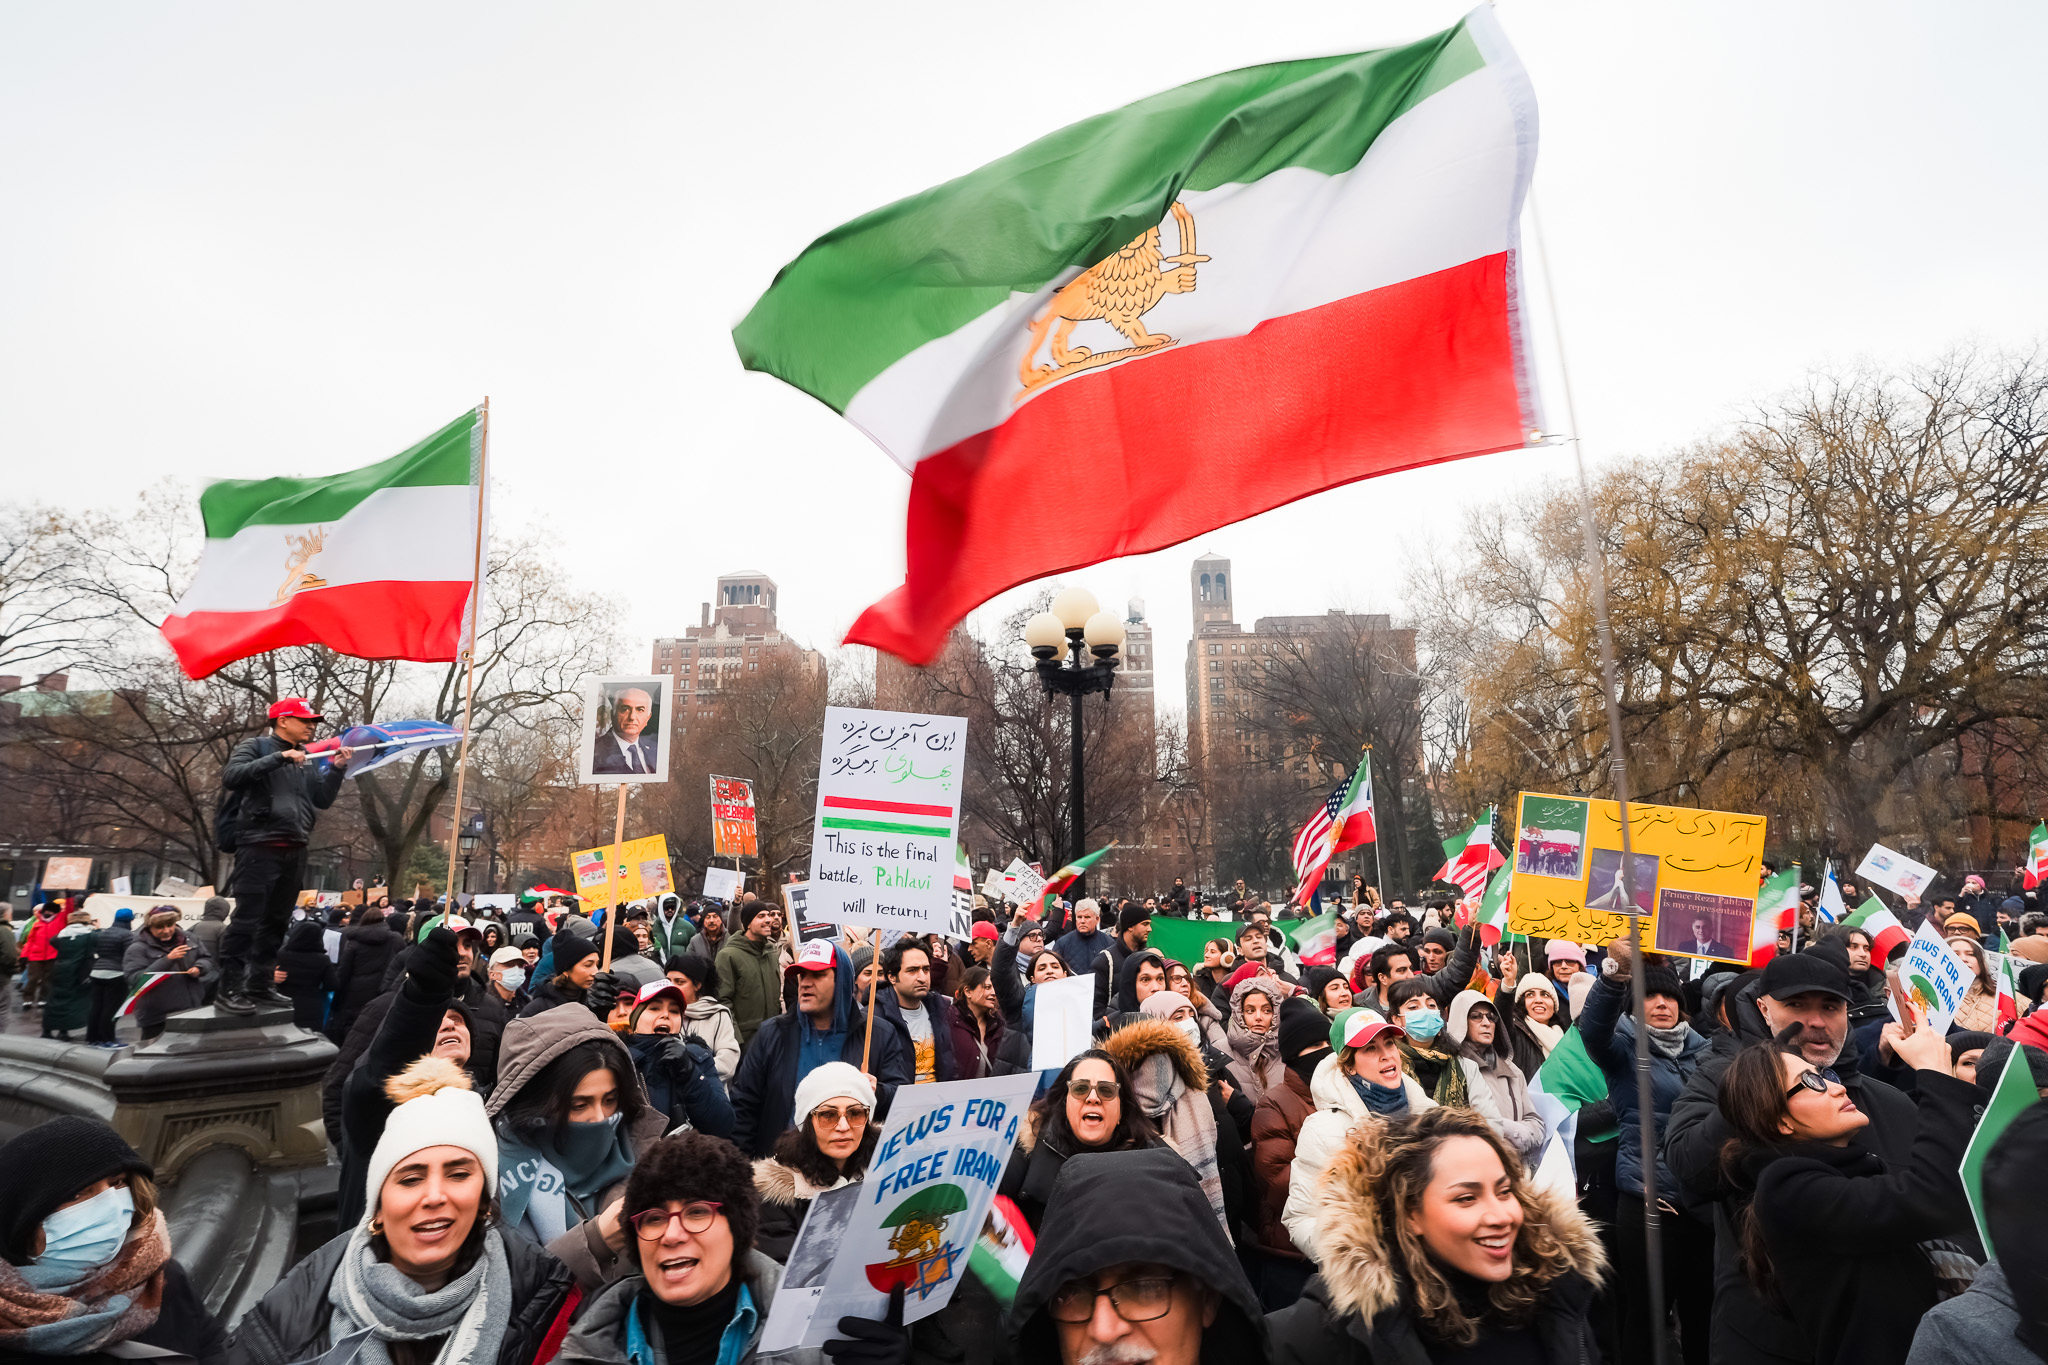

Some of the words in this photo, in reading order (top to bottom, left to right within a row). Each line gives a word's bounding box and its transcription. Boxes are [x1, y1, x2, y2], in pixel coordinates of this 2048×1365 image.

[869, 720, 931, 750] آخرین
[925, 731, 956, 751] این
[884, 753, 952, 791] پهلوی
[716, 779, 749, 801] END
[824, 831, 857, 855] This
[861, 842, 873, 857] is
[877, 841, 900, 859] the
[905, 842, 938, 862] final
[1665, 854, 1754, 873] است
[872, 865, 932, 890] Pahlavi
[1017, 866, 1047, 892] DEMOCR
[1020, 880, 1039, 897] FOR
[876, 903, 928, 920] return!
[1663, 899, 1671, 907] is
[1672, 903, 1687, 911] my
[1688, 904, 1752, 917] representative
[1664, 890, 1692, 900] Prince
[1694, 893, 1716, 904] Reza
[1718, 896, 1751, 908] Pahlavi
[510, 922, 533, 935] NYPD
[1911, 939, 1940, 957] JEWS
[1940, 957, 1959, 985] FOR
[1956, 986, 1964, 1001] A
[1909, 955, 1936, 979] FREE
[1934, 975, 1955, 1016] IRAN!
[873, 1104, 955, 1172] JEWS
[961, 1098, 1007, 1132] FOR
[1004, 1115, 1018, 1145] A
[874, 1150, 949, 1205] FREE
[952, 1148, 1002, 1190] IRAN!
